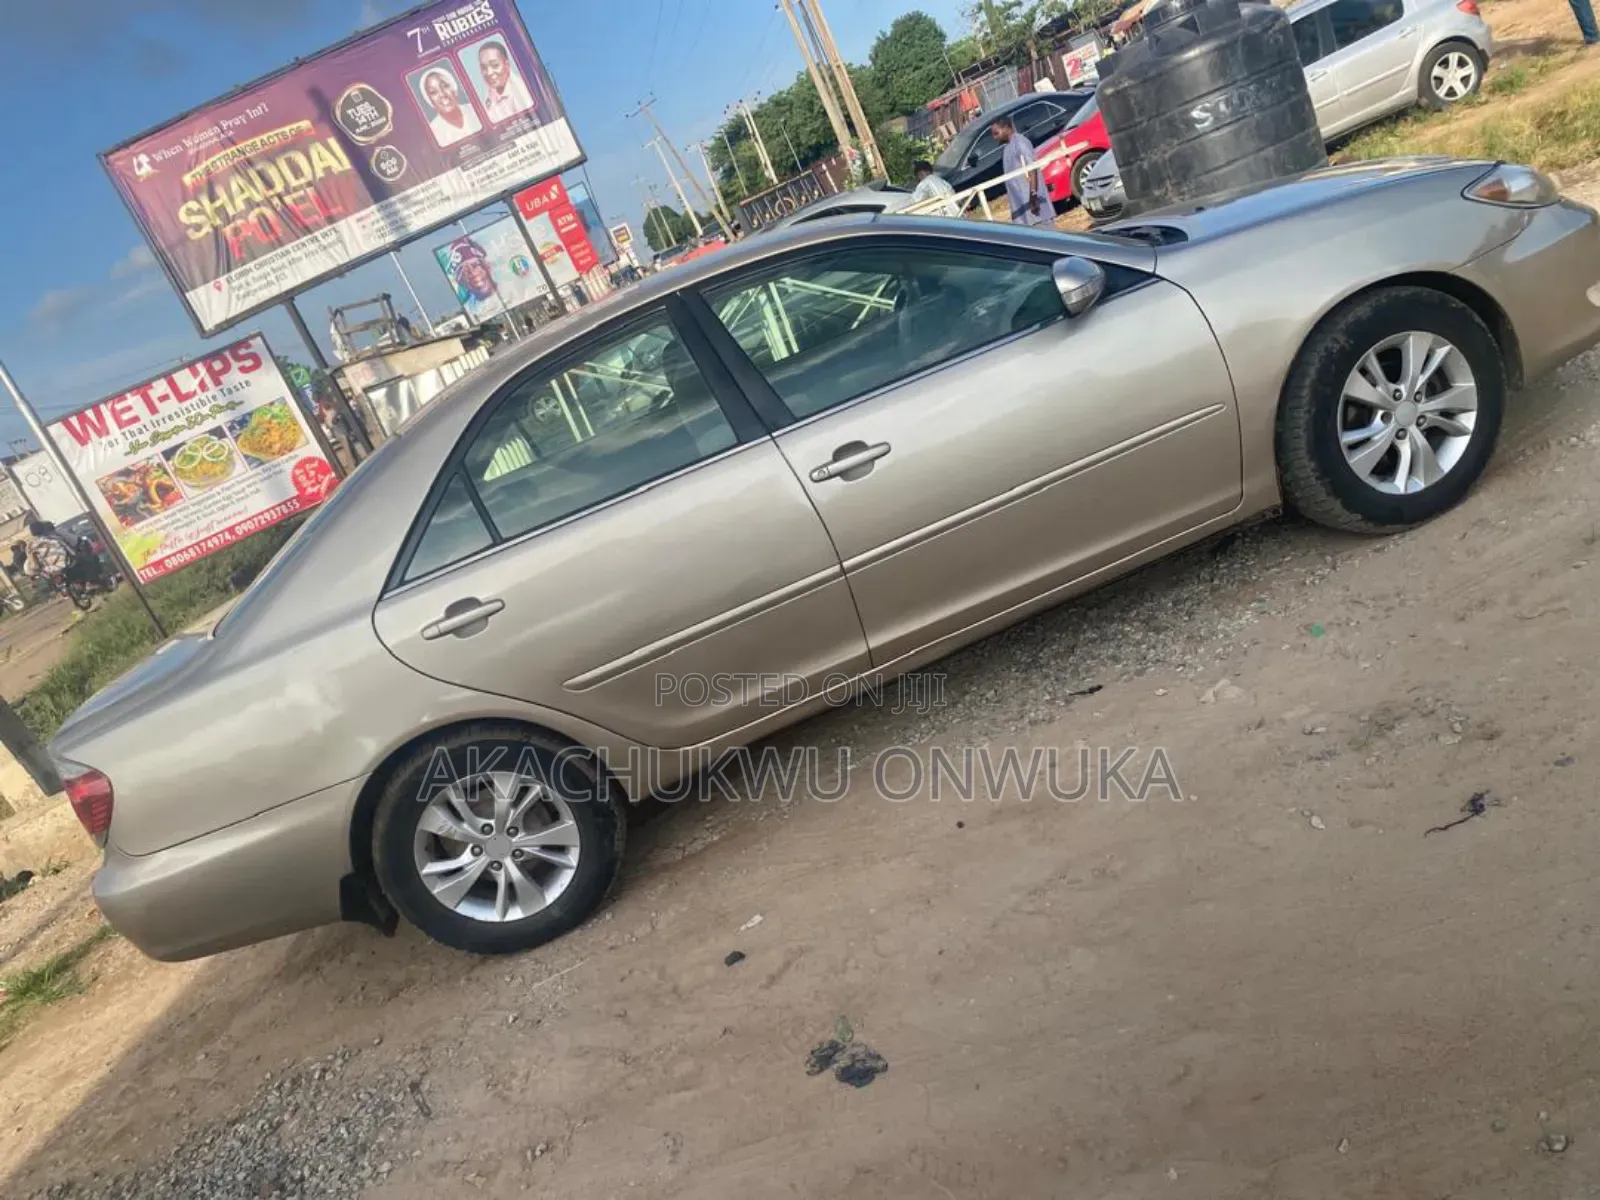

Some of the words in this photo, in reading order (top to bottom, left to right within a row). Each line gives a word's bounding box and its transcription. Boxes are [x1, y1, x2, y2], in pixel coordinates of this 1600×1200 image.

[434, 0, 494, 40] RUBIES
[353, 106, 380, 125] 14TH
[151, 143, 183, 163] When
[181, 124, 222, 148] Women
[219, 112, 248, 132] Pray
[205, 140, 261, 171] STRANGE
[257, 128, 289, 149] ACTS
[175, 135, 352, 242] SHADDAI
[526, 195, 549, 211] UBA
[252, 248, 291, 270] CHRISTIAN
[61, 341, 263, 448] WET-LIPS
[120, 422, 150, 441] That
[151, 393, 219, 429] Irresistible
[217, 376, 252, 399] Taste
